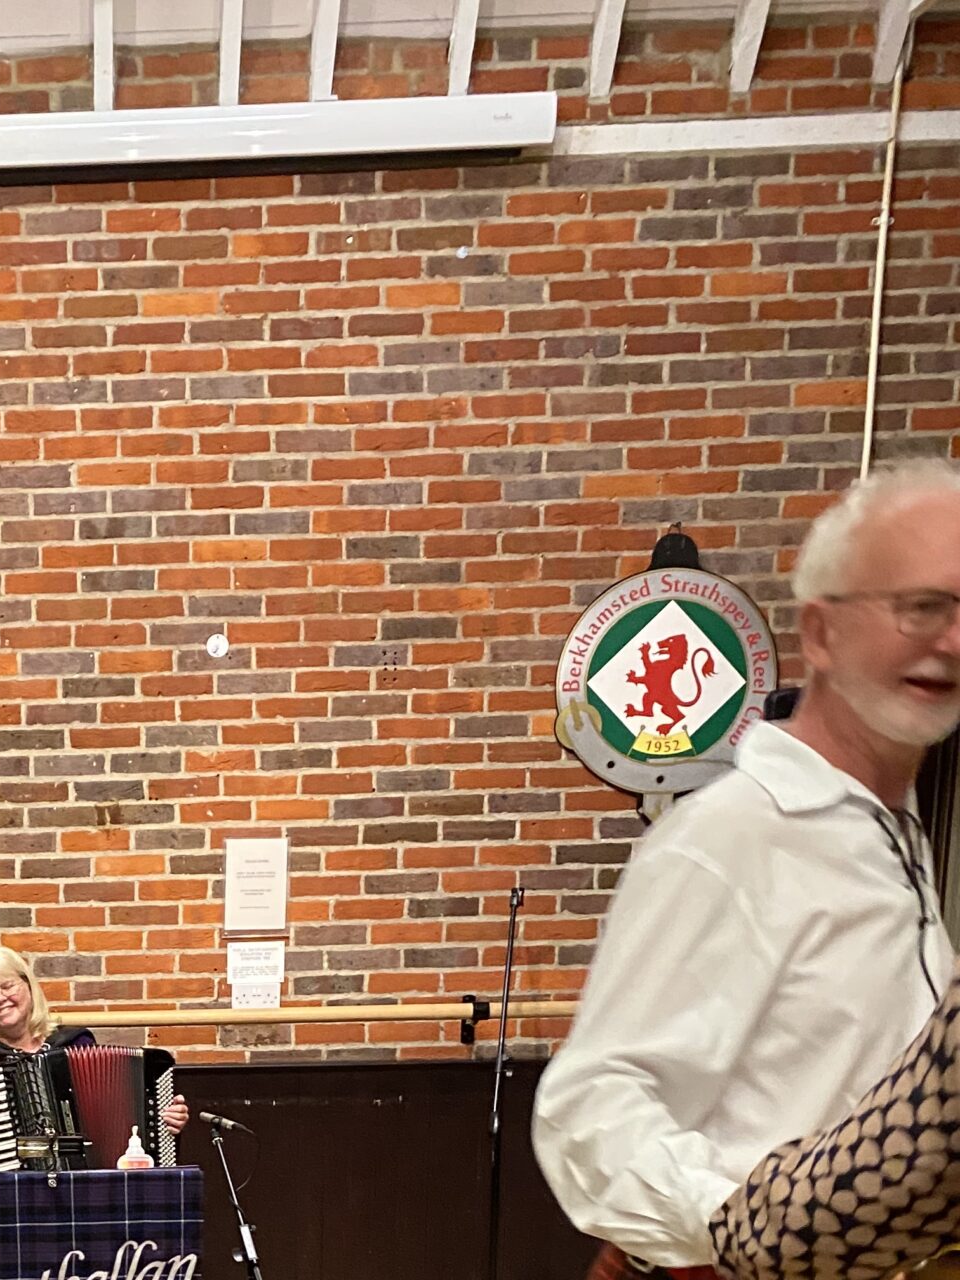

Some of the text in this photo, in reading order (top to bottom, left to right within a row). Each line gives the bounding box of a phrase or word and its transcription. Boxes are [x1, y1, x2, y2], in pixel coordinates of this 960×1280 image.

[661, 573, 752, 631] Strathspey
[562, 577, 651, 692] Berkhamsted
[746, 632, 761, 648] &
[752, 649, 769, 694] Reel
[645, 739, 681, 752] 1952
